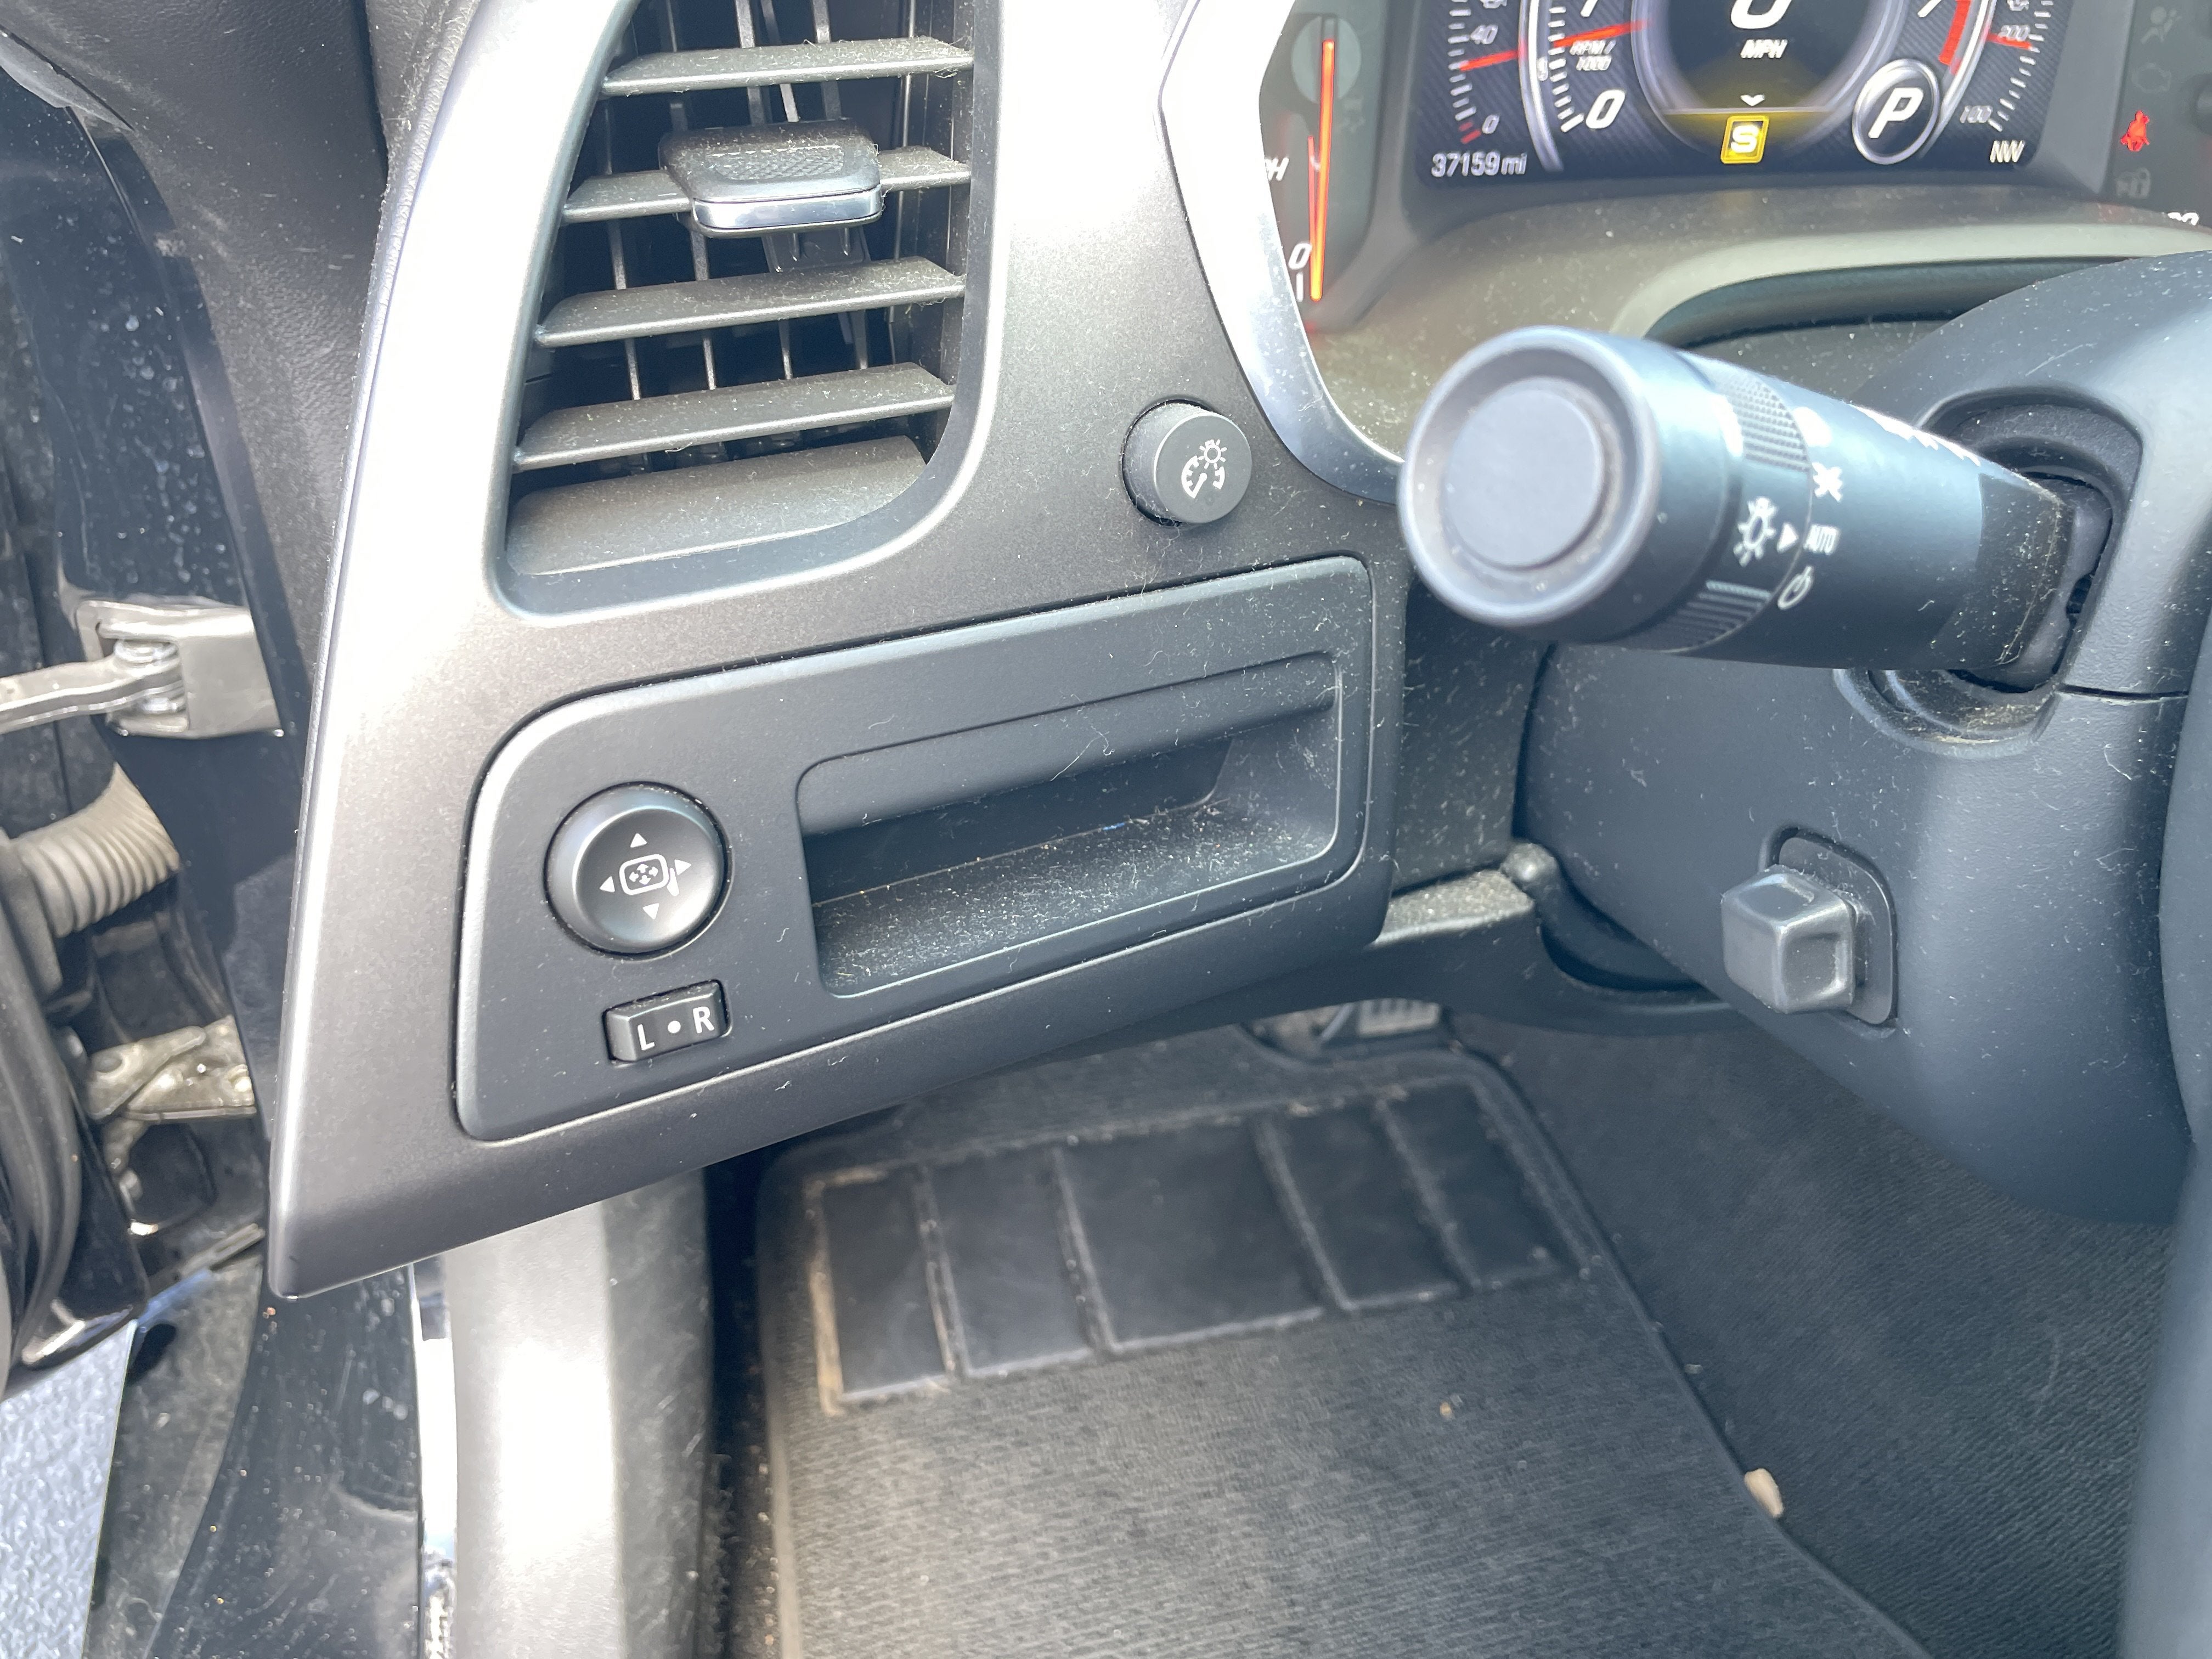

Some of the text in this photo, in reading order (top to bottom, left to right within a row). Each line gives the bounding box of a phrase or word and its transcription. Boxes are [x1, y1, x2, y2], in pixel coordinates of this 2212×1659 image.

[1470, 25, 1498, 44] 40
[1740, 39, 1788, 58] MPH
[1576, 55, 1612, 71] 1000
[1585, 89, 1626, 129] 0
[1868, 87, 1923, 139] P
[1960, 105, 1993, 123] 100
[1482, 114, 1500, 134] 0
[1730, 124, 1760, 154] S
[1989, 140, 2025, 163] NW
[1431, 151, 1527, 177] 37159 mi
[1288, 241, 1312, 269] 0
[637, 1006, 715, 1051] L R
